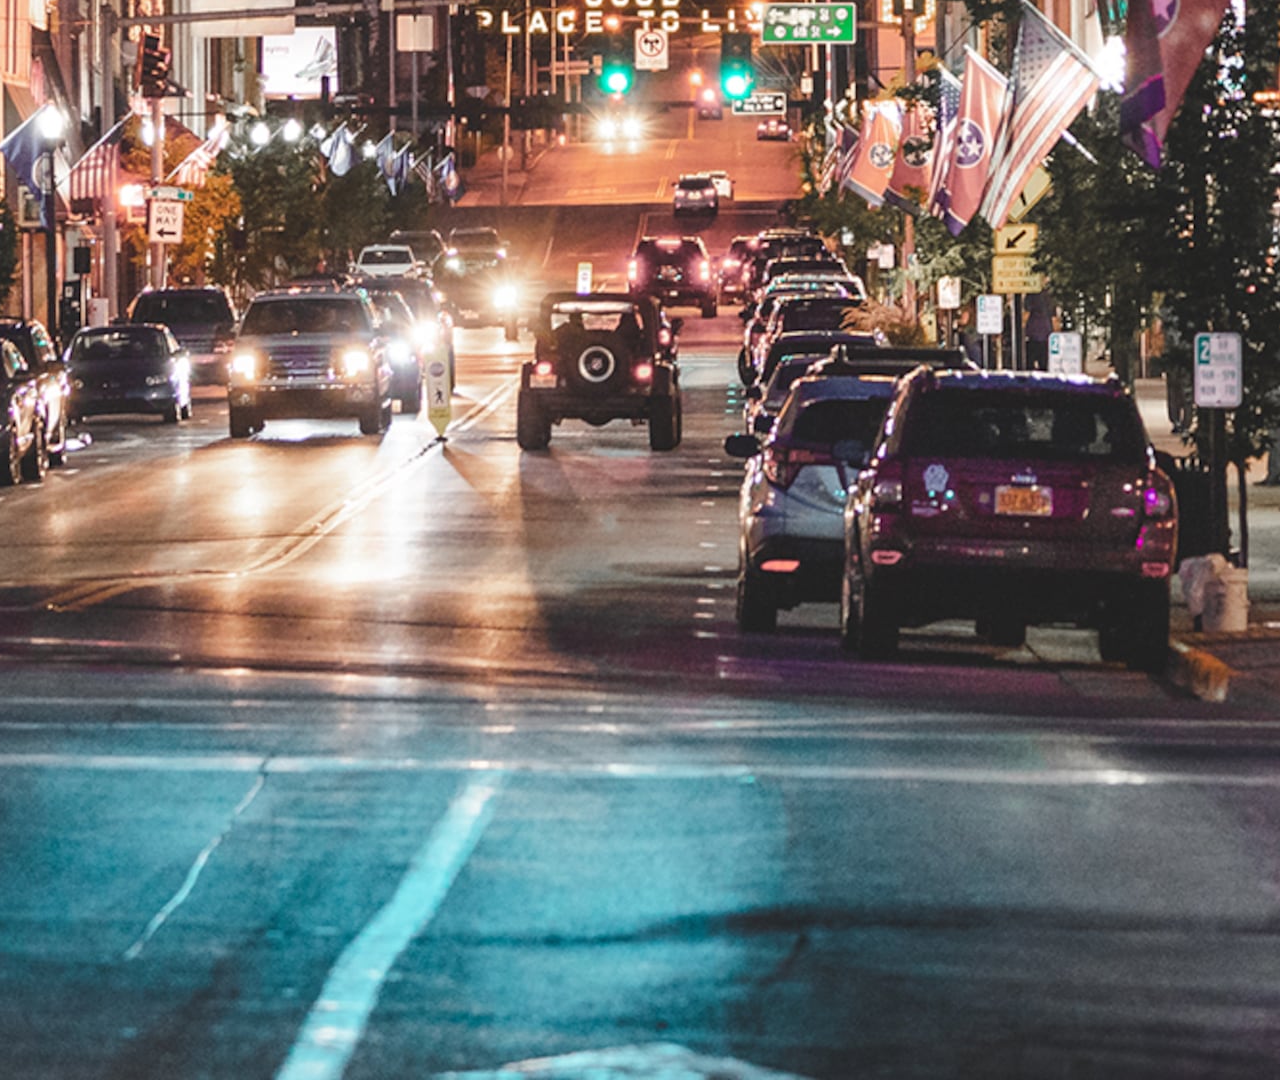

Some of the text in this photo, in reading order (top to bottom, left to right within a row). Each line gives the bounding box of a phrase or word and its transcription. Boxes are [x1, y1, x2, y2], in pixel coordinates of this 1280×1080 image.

[474, 8, 604, 34] PLACE
[637, 9, 681, 33] TO
[157, 205, 177, 215] ONE
[156, 216, 177, 225] WAY
[1201, 340, 1210, 360] 2
